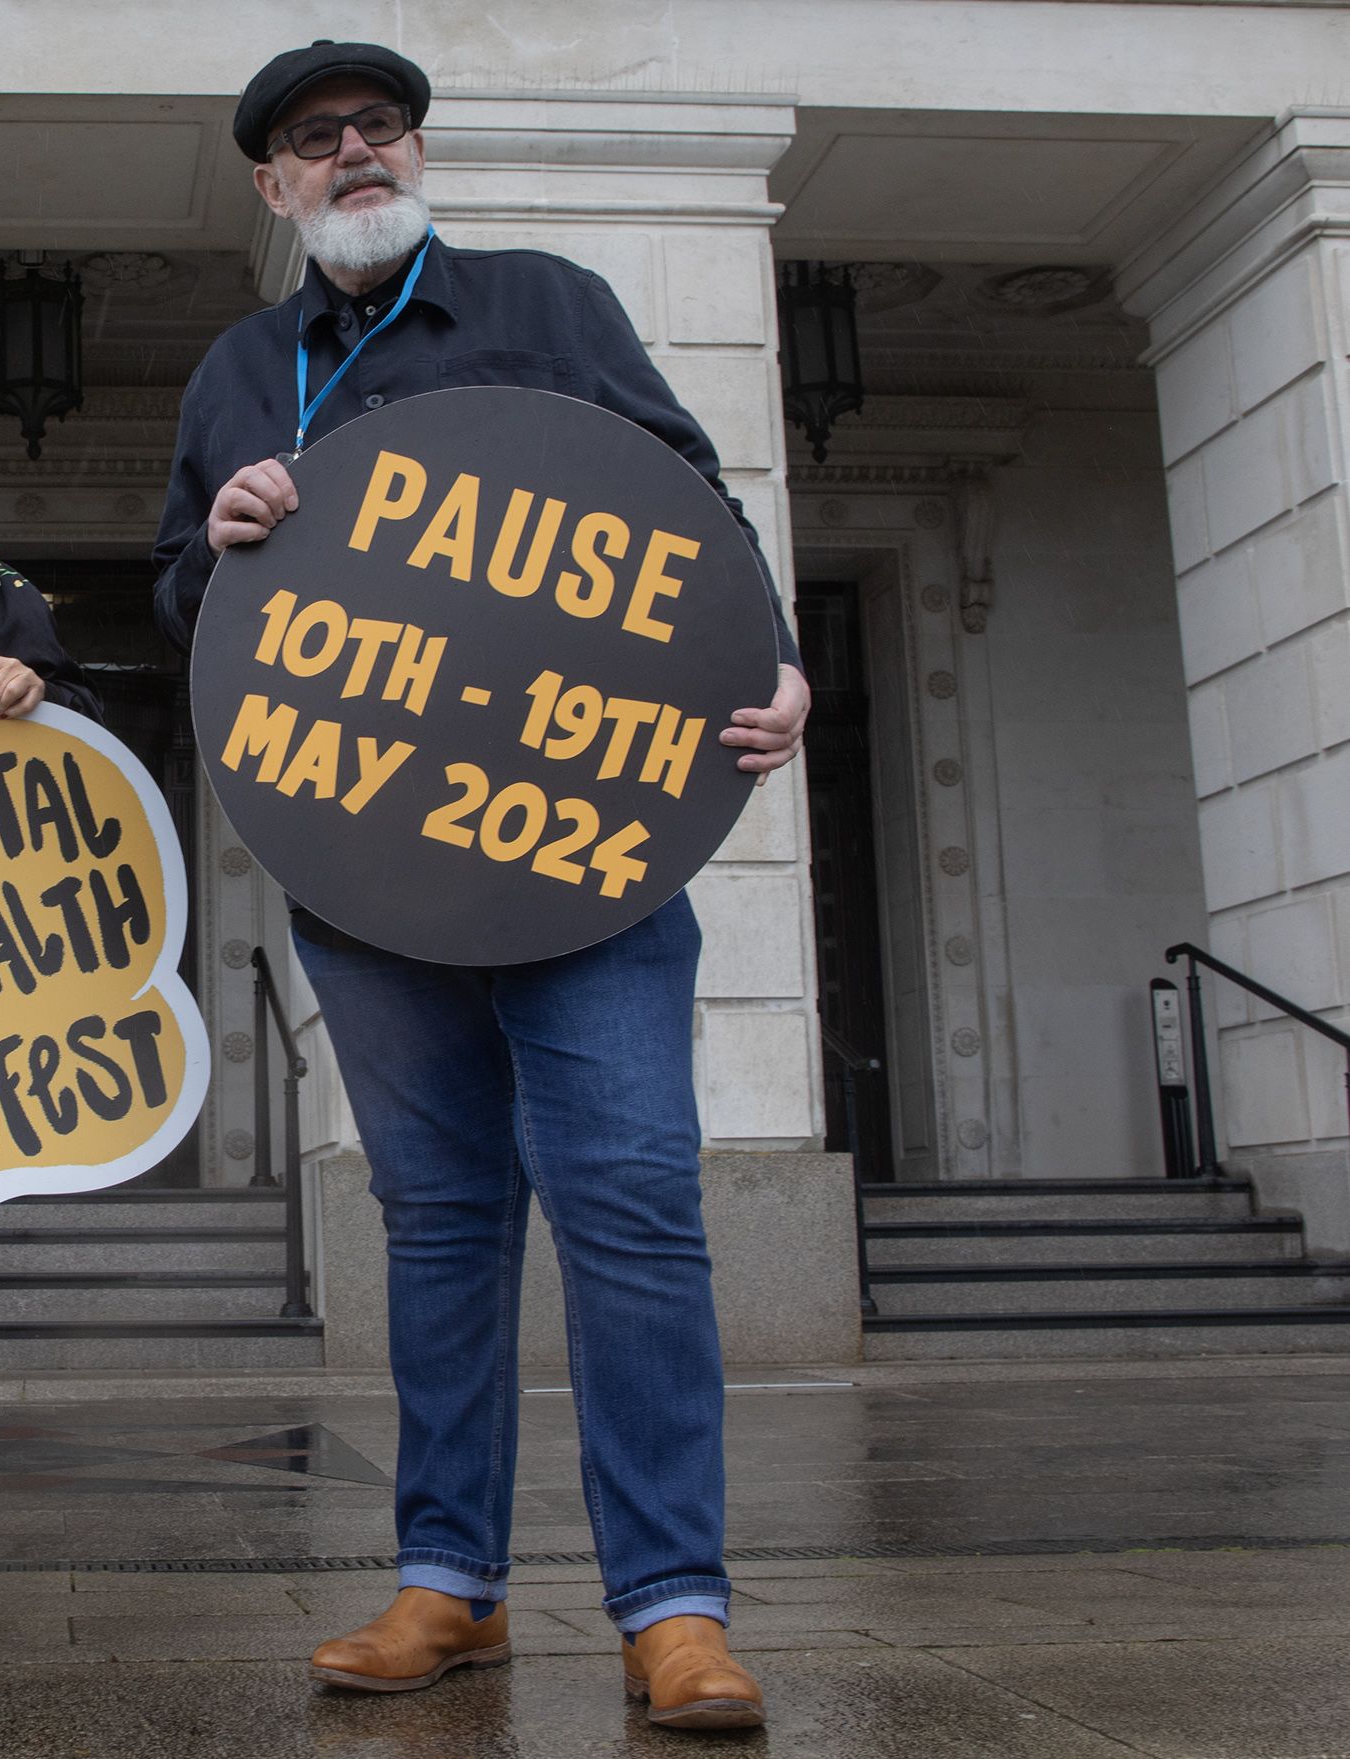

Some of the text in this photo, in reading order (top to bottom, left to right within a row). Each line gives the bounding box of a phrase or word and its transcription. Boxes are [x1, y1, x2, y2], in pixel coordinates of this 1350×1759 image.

[348, 450, 701, 644] PAUSE
[254, 588, 448, 717] 10TH
[520, 669, 707, 799] 19TH
[220, 694, 651, 899] MAY 2024
